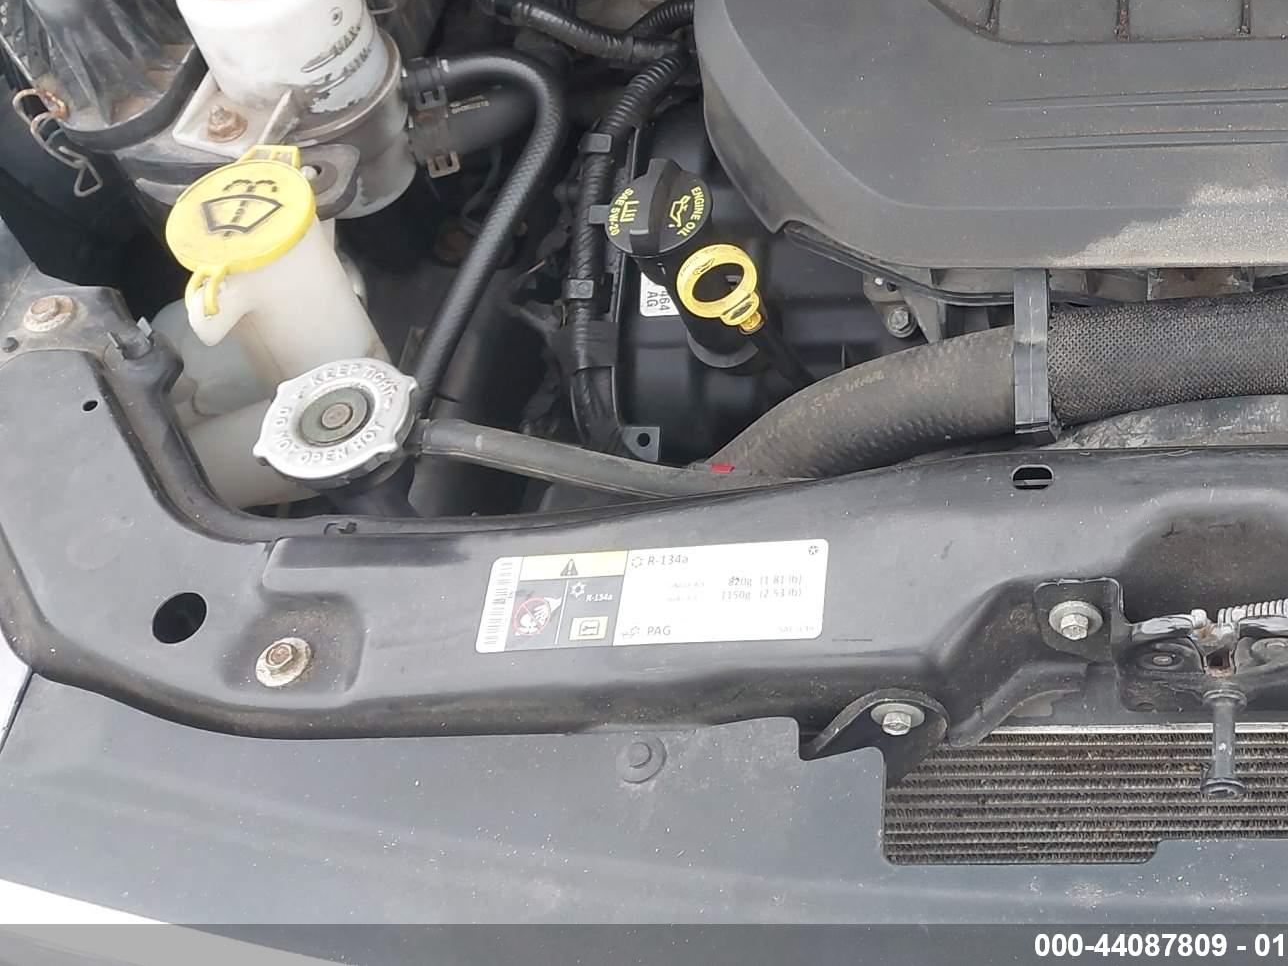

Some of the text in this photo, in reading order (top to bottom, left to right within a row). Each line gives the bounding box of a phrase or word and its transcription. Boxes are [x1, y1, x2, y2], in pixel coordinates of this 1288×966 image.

[607, 188, 635, 236] SAE 5W-20
[690, 186, 705, 221] ENGINE
[676, 223, 696, 237] OIL
[647, 290, 659, 308] AG
[311, 363, 361, 385] KEEP
[301, 447, 349, 463] OPEN
[647, 554, 689, 566] R-134a
[647, 625, 671, 636] PAG
